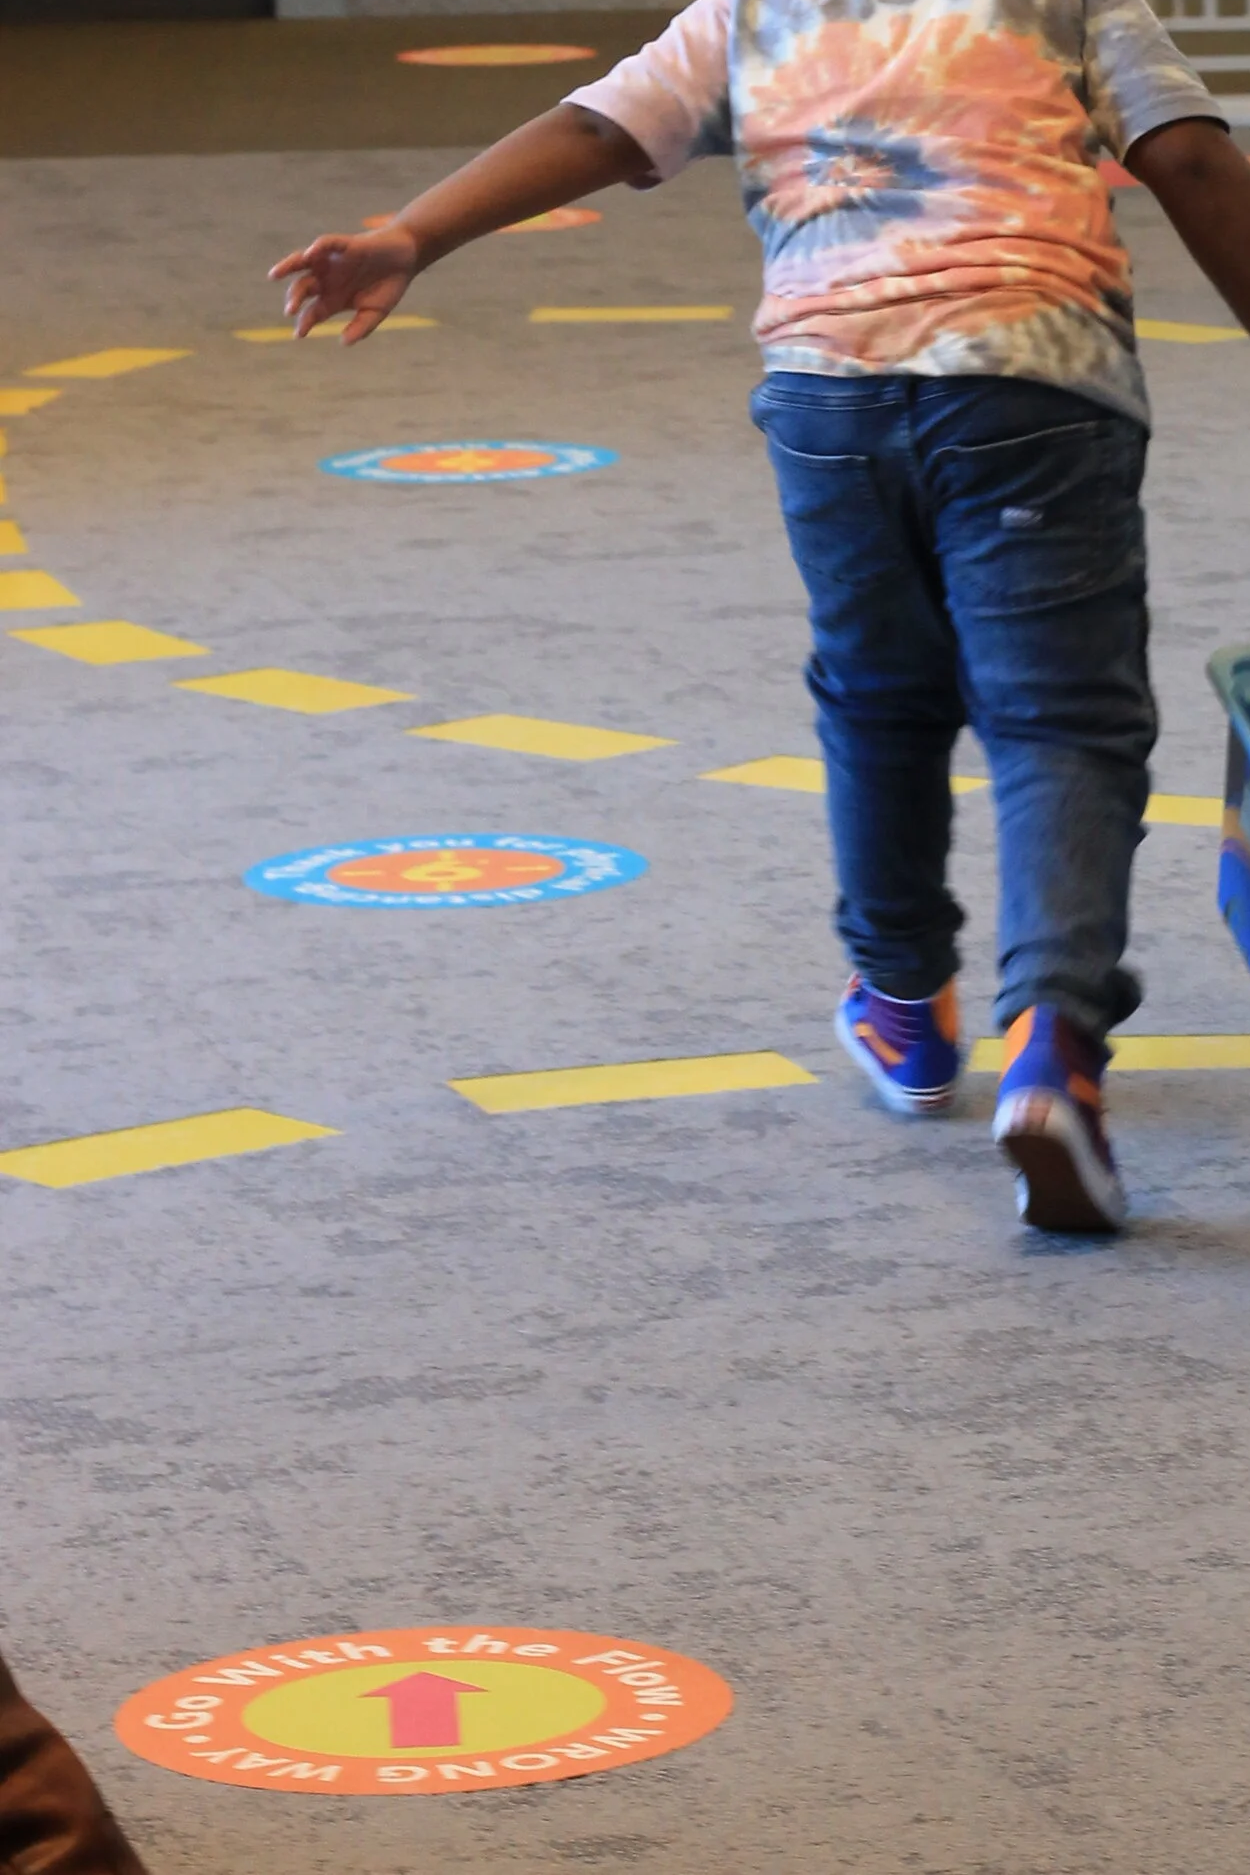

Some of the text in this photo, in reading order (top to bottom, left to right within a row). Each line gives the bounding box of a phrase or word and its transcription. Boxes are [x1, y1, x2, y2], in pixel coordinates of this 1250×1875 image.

[376, 836, 476, 853] you
[144, 1633, 687, 1731] Go With the Flow
[186, 1725, 666, 1785] WRONG WAY
